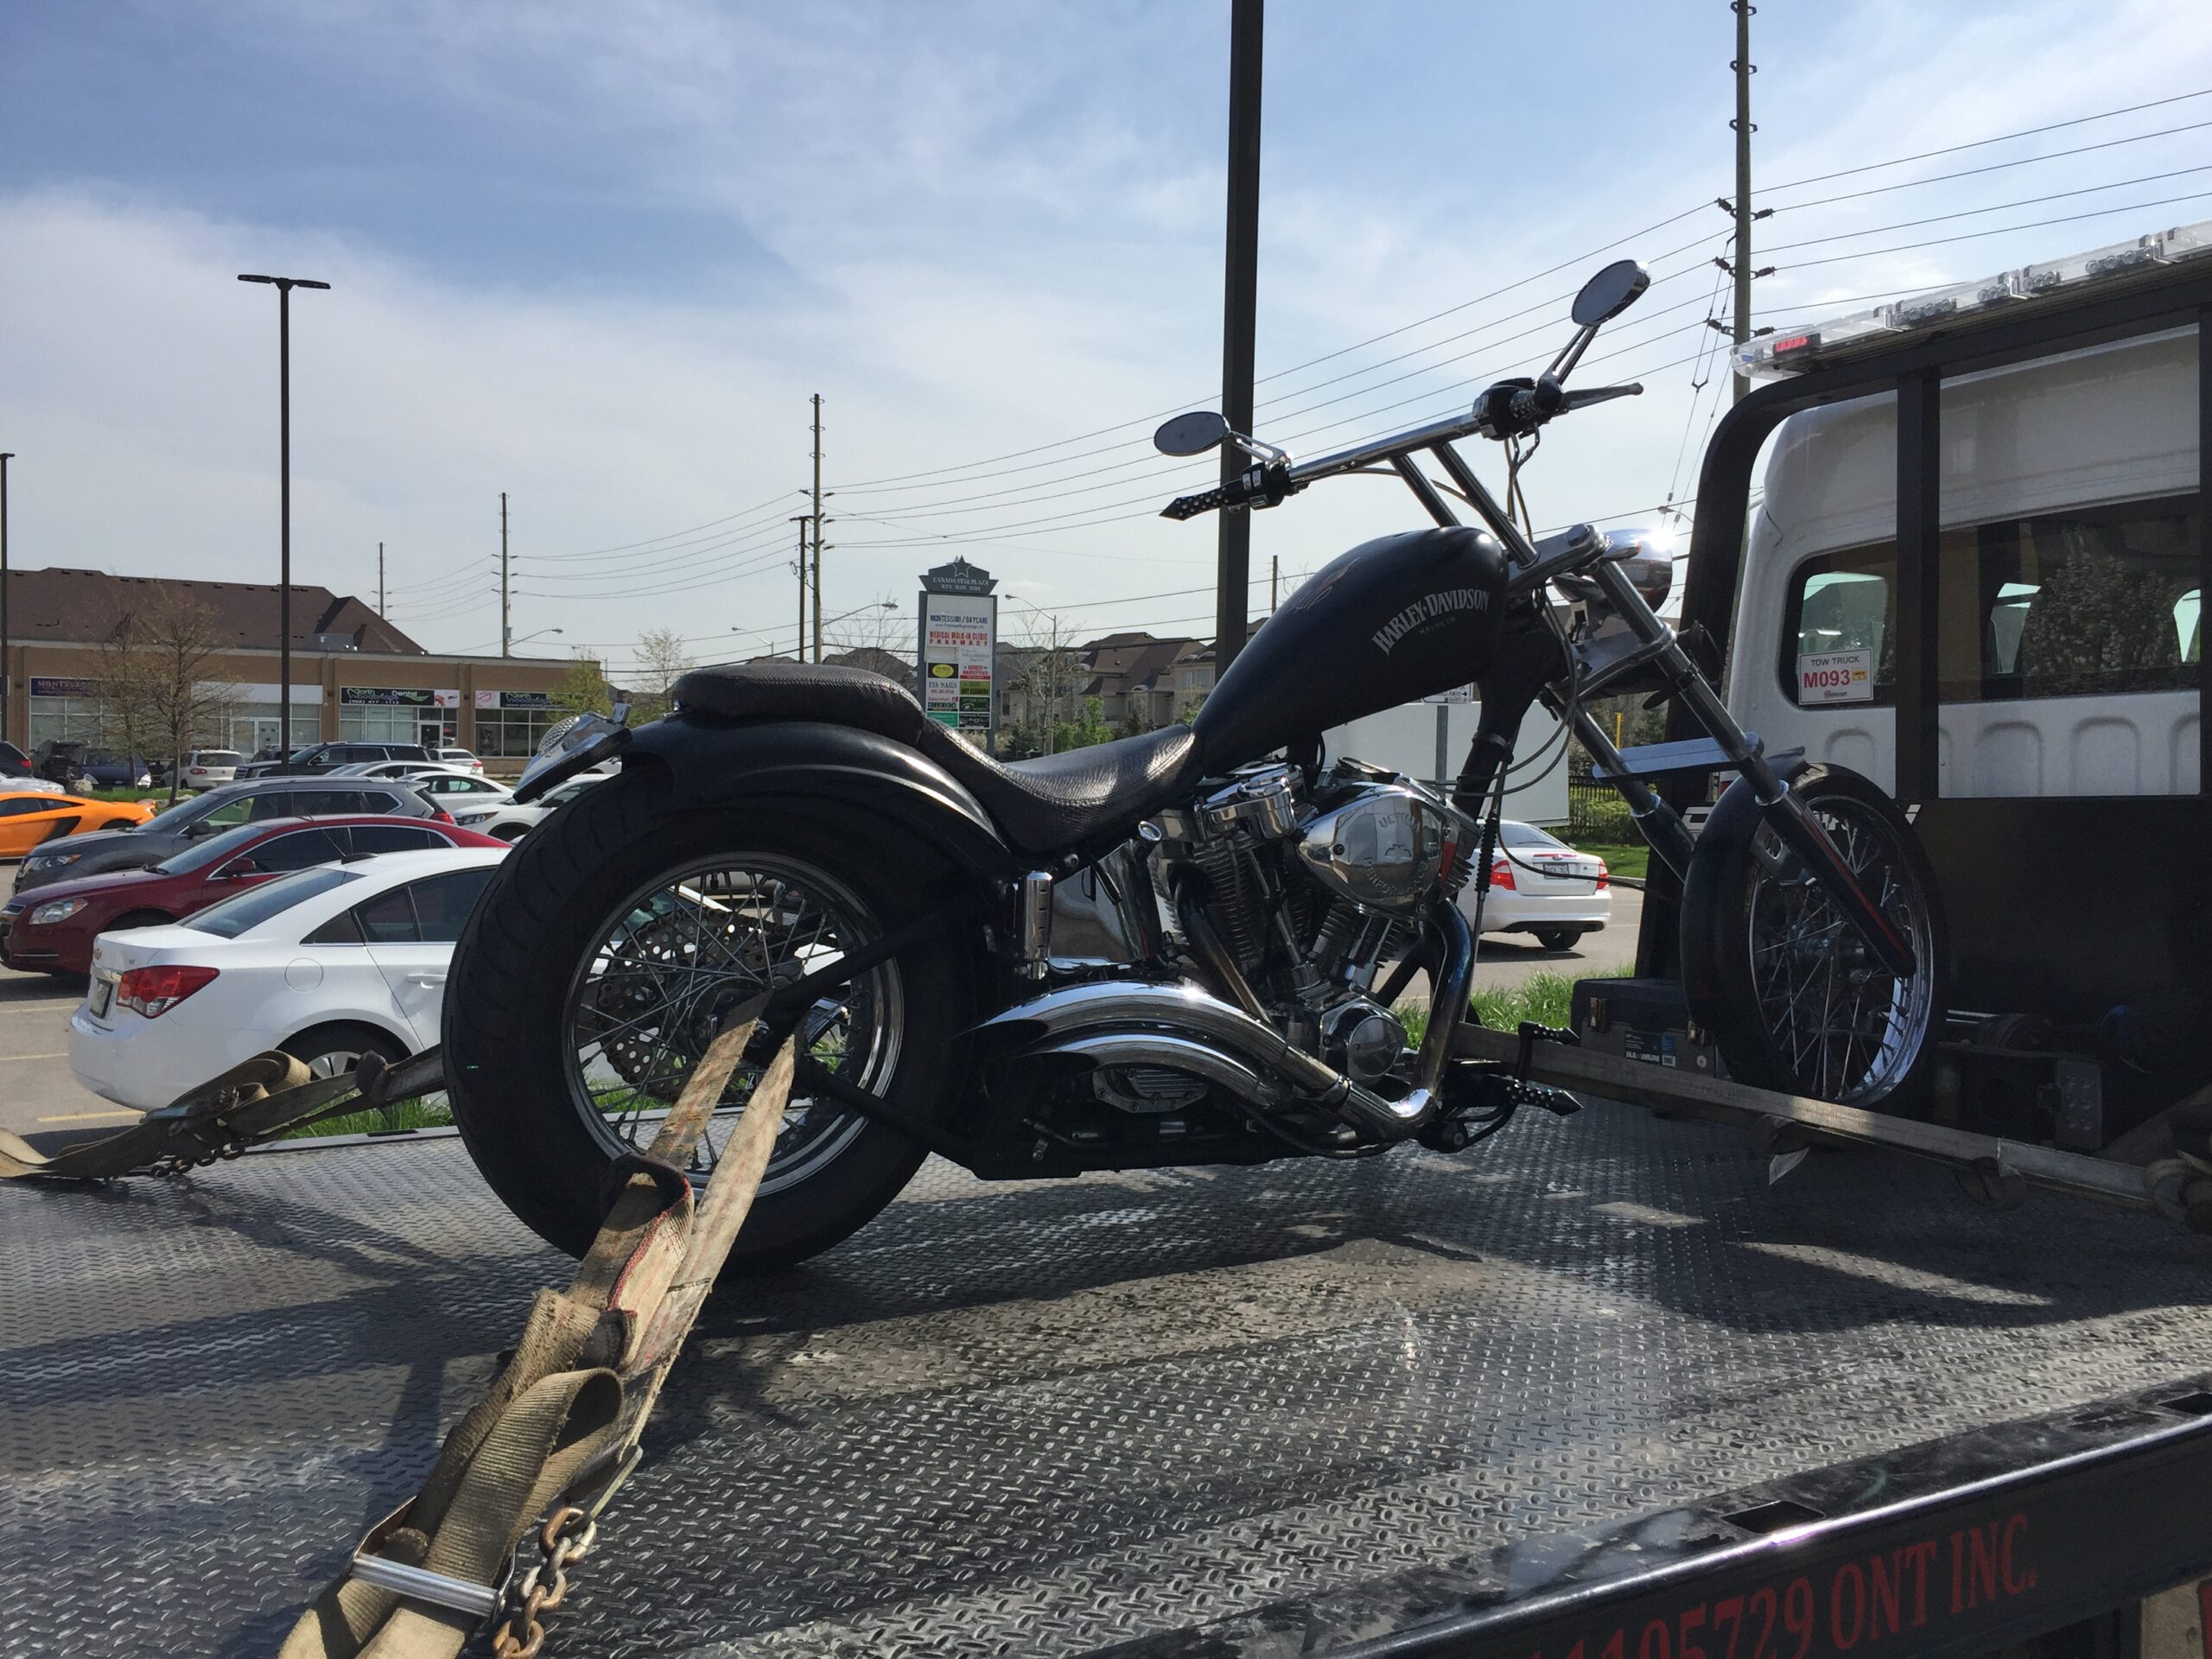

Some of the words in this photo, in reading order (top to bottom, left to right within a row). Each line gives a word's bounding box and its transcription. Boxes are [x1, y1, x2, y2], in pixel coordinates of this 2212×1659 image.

[1832, 656, 1860, 664] TRUCK
[1803, 670, 1851, 689] M093
[1565, 1578, 1814, 1659] 05729
[1830, 1541, 1937, 1649] ONT
[1950, 1513, 2037, 1614] INC.
